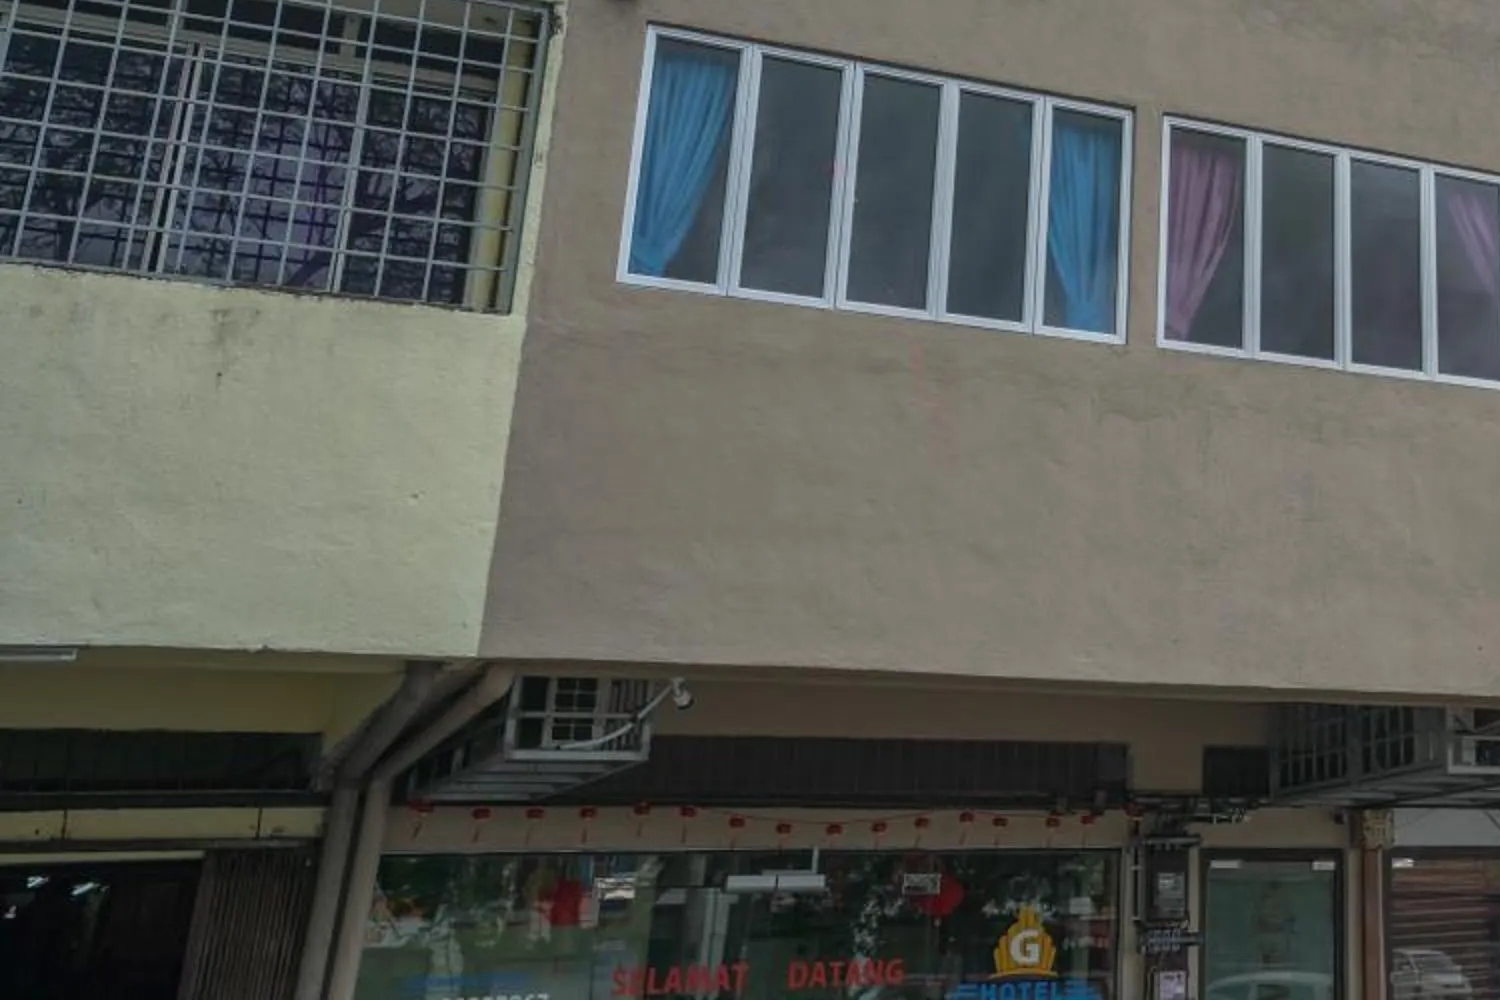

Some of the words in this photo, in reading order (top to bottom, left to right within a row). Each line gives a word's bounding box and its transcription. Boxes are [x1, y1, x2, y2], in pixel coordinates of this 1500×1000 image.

[1010, 929, 1041, 965] G
[611, 958, 751, 997] SELAMAT
[786, 957, 906, 990] DATANG
